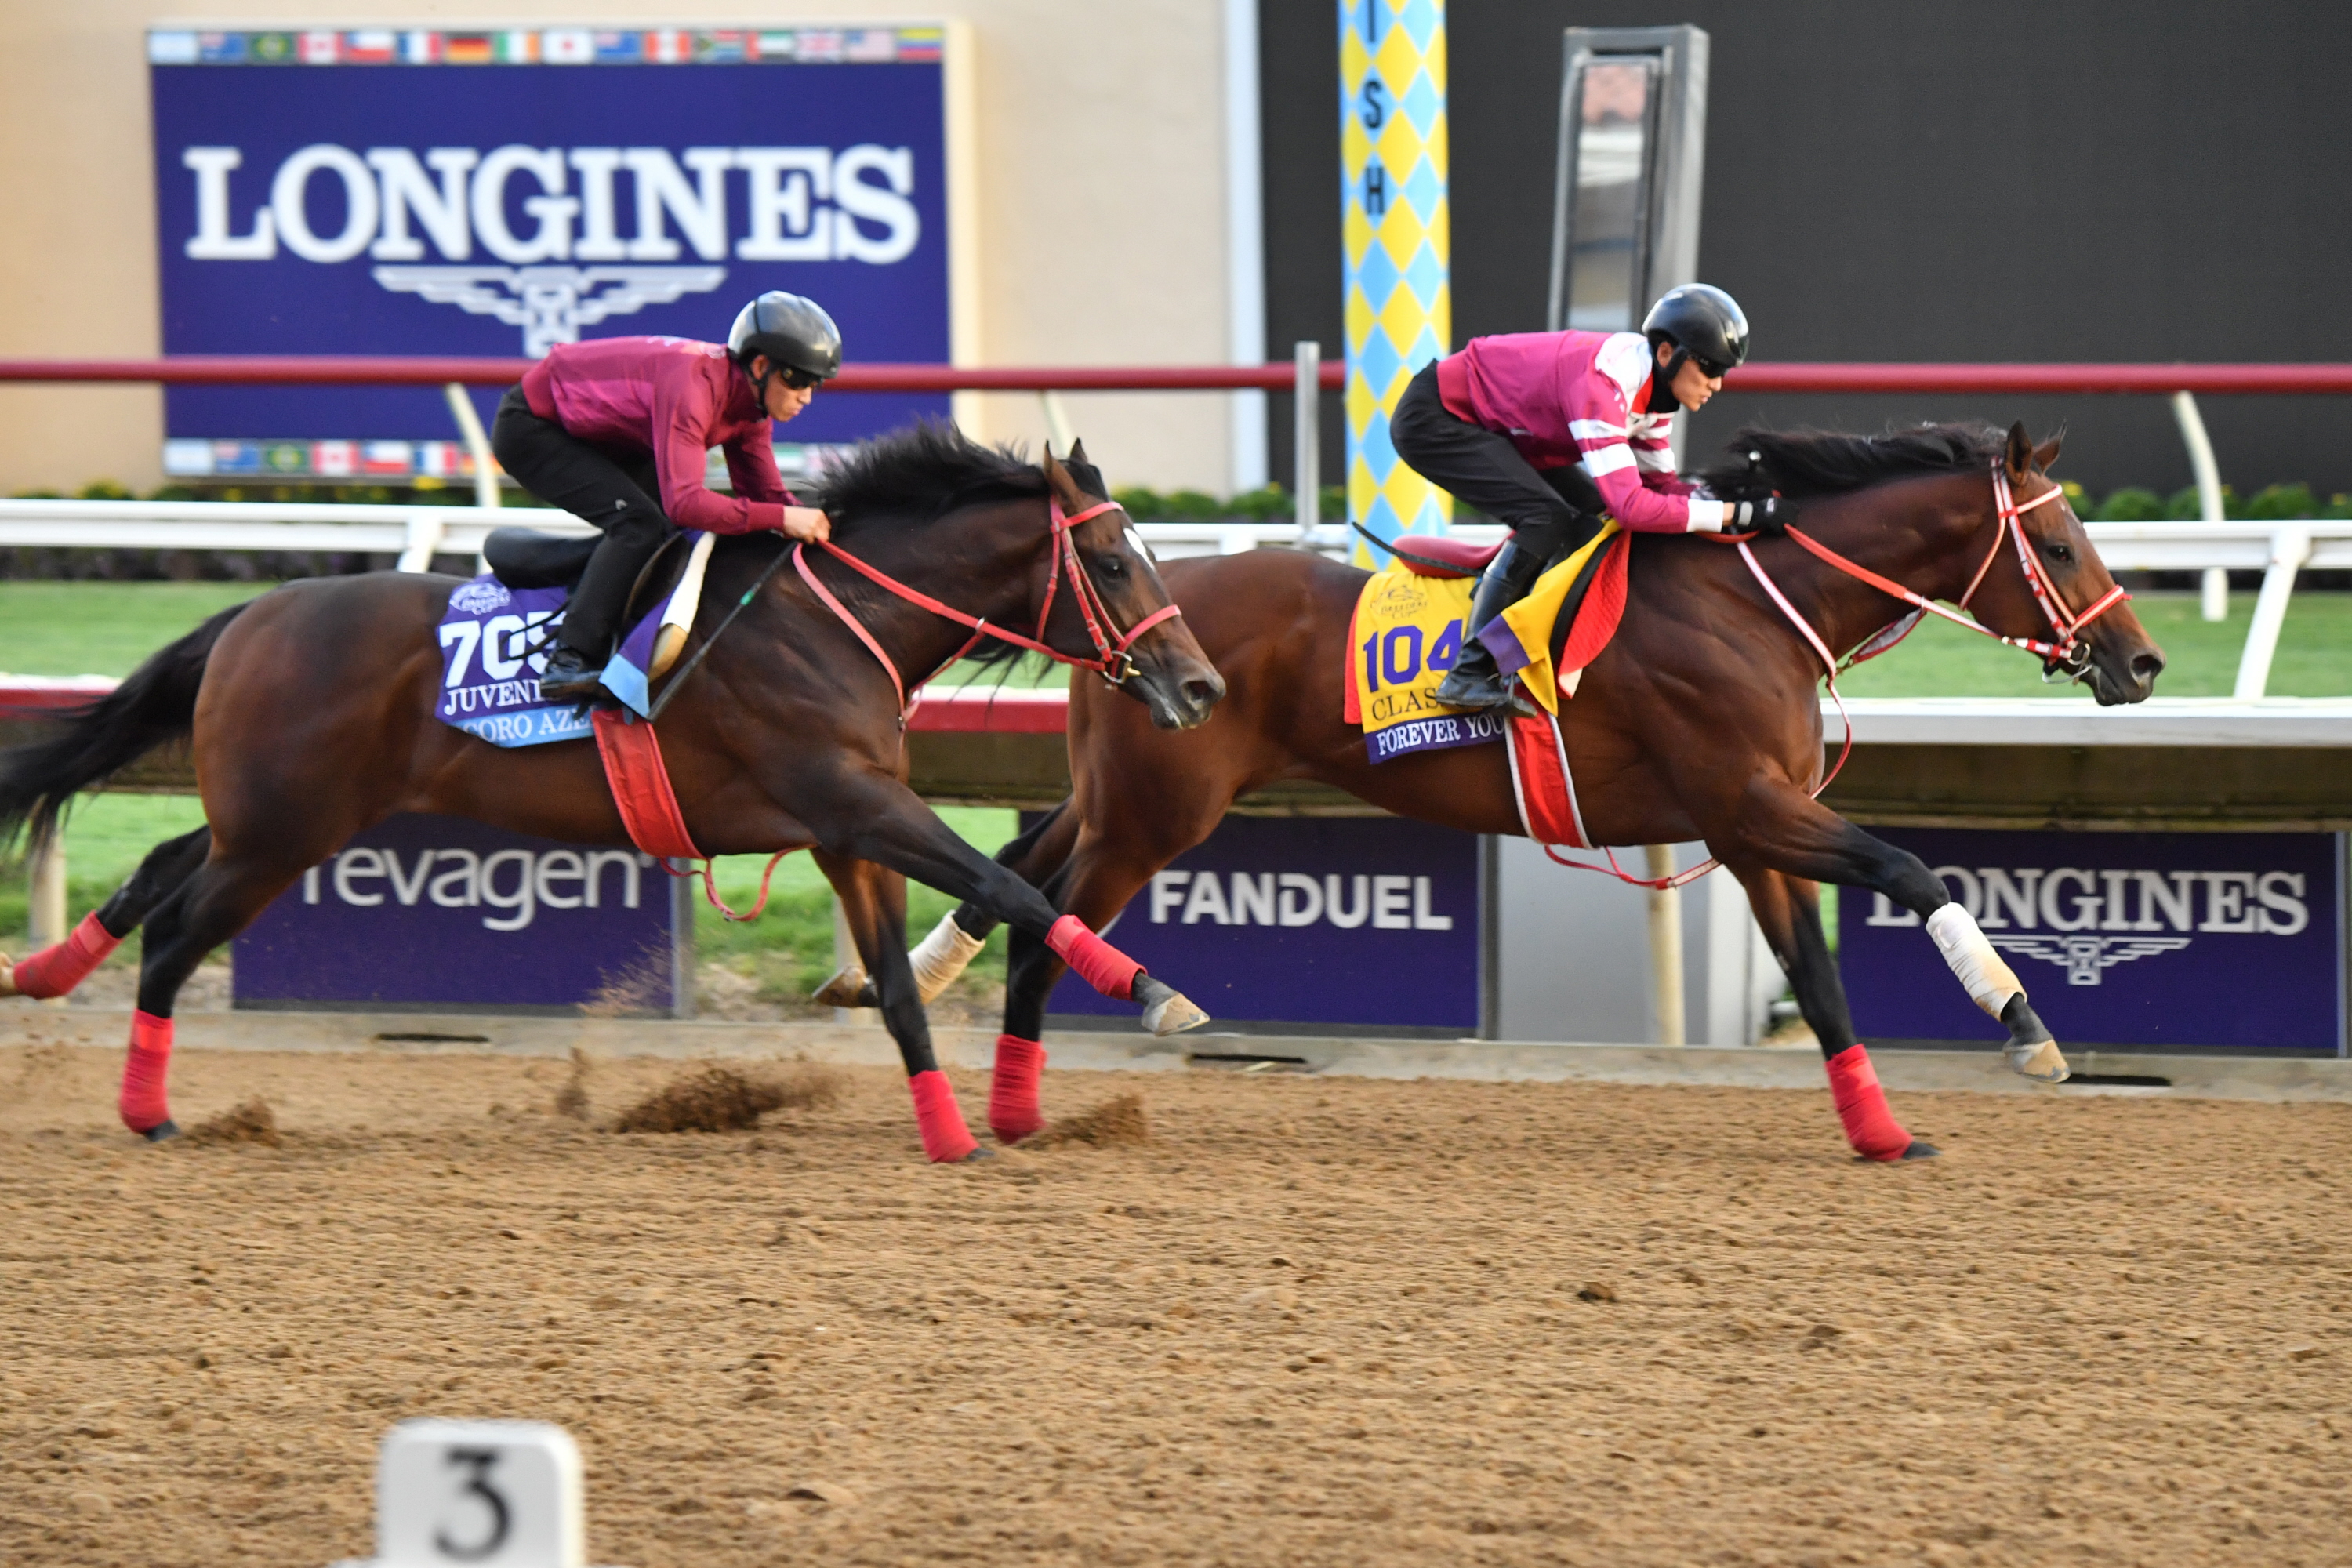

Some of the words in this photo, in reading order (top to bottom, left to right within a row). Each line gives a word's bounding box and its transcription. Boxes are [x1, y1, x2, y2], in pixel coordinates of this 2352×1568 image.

[183, 143, 920, 264] LONGINES
[1363, 619, 1463, 693] 104
[1372, 687, 1441, 721] CLAS
[1376, 718, 1461, 756] FOREVER
[1149, 870, 1453, 930] FANDUEL
[434, 1446, 511, 1560] 3
